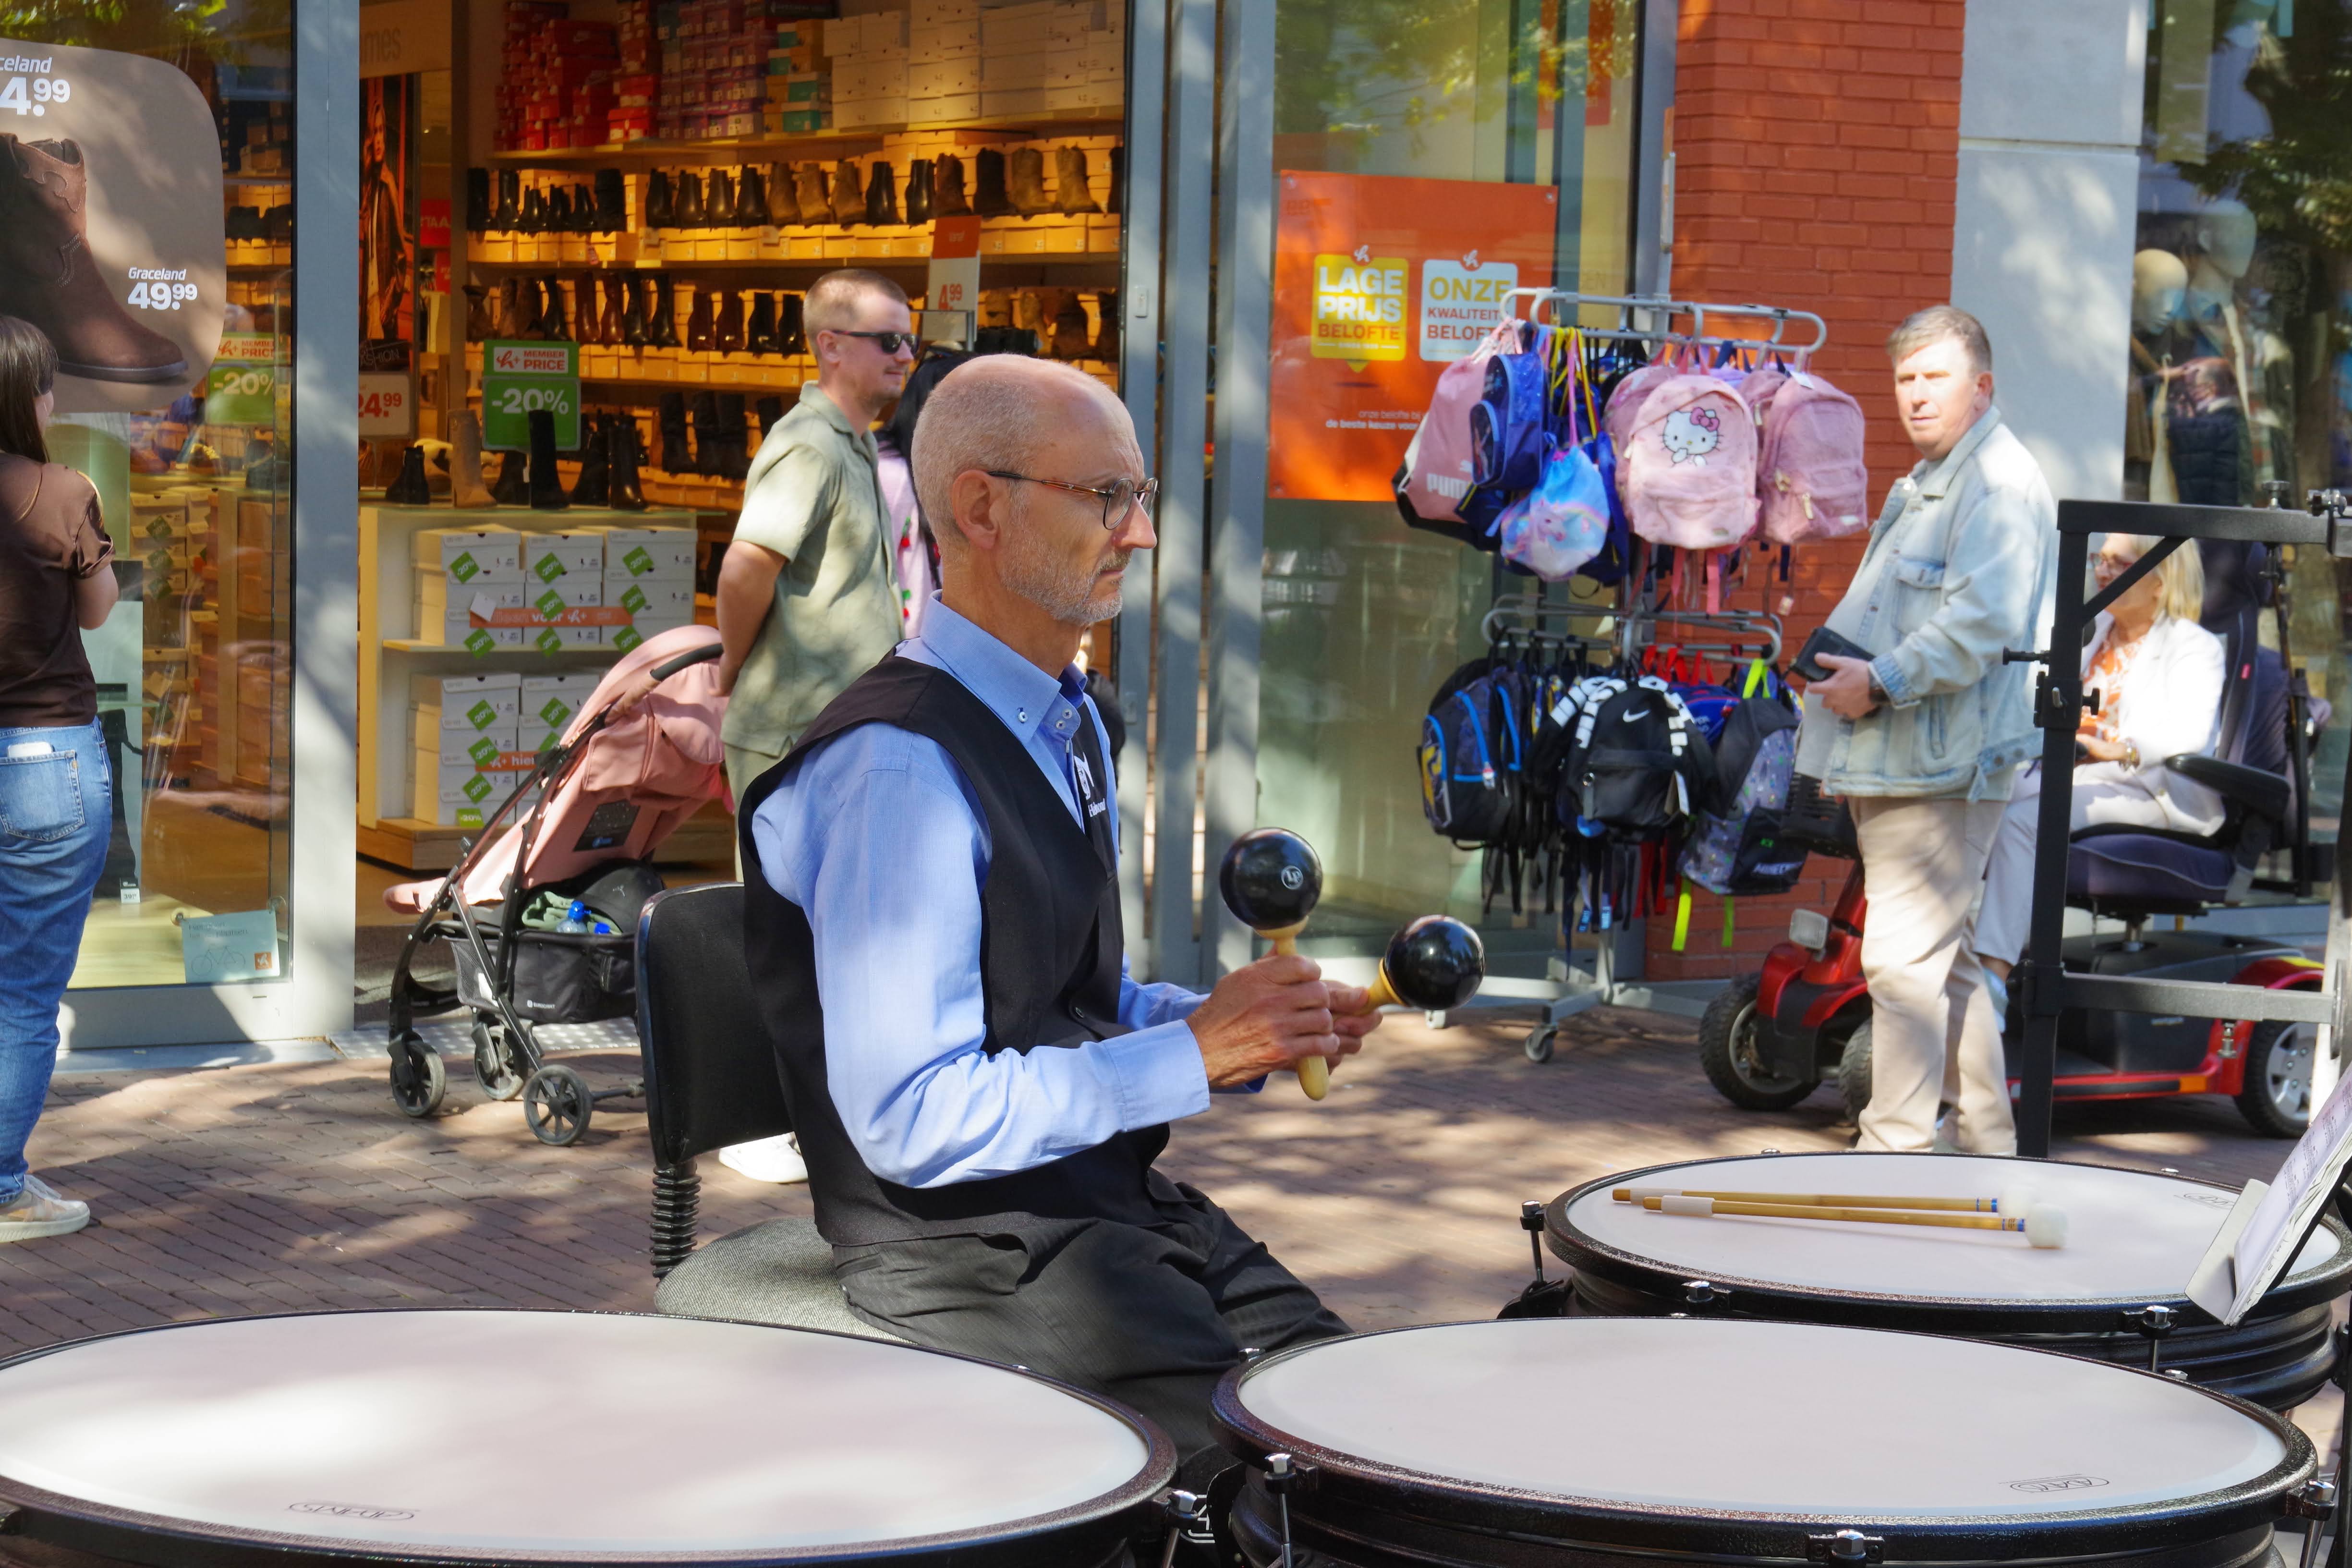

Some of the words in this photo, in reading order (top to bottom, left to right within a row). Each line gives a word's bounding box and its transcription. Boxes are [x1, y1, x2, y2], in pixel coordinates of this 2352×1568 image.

[128, 267, 187, 281] Graceland
[1319, 266, 1404, 295] LAGE
[127, 282, 198, 310] 49.99
[1429, 276, 1511, 303] ONZE
[1317, 295, 1401, 323] PRIJS
[1427, 306, 1509, 321] KWALITEIT
[1318, 323, 1401, 340] BELOFTE
[523, 350, 565, 358] MEMBER
[523, 359, 566, 370] PRICE
[491, 388, 569, 415] -20%
[1427, 472, 1469, 500] PUM
